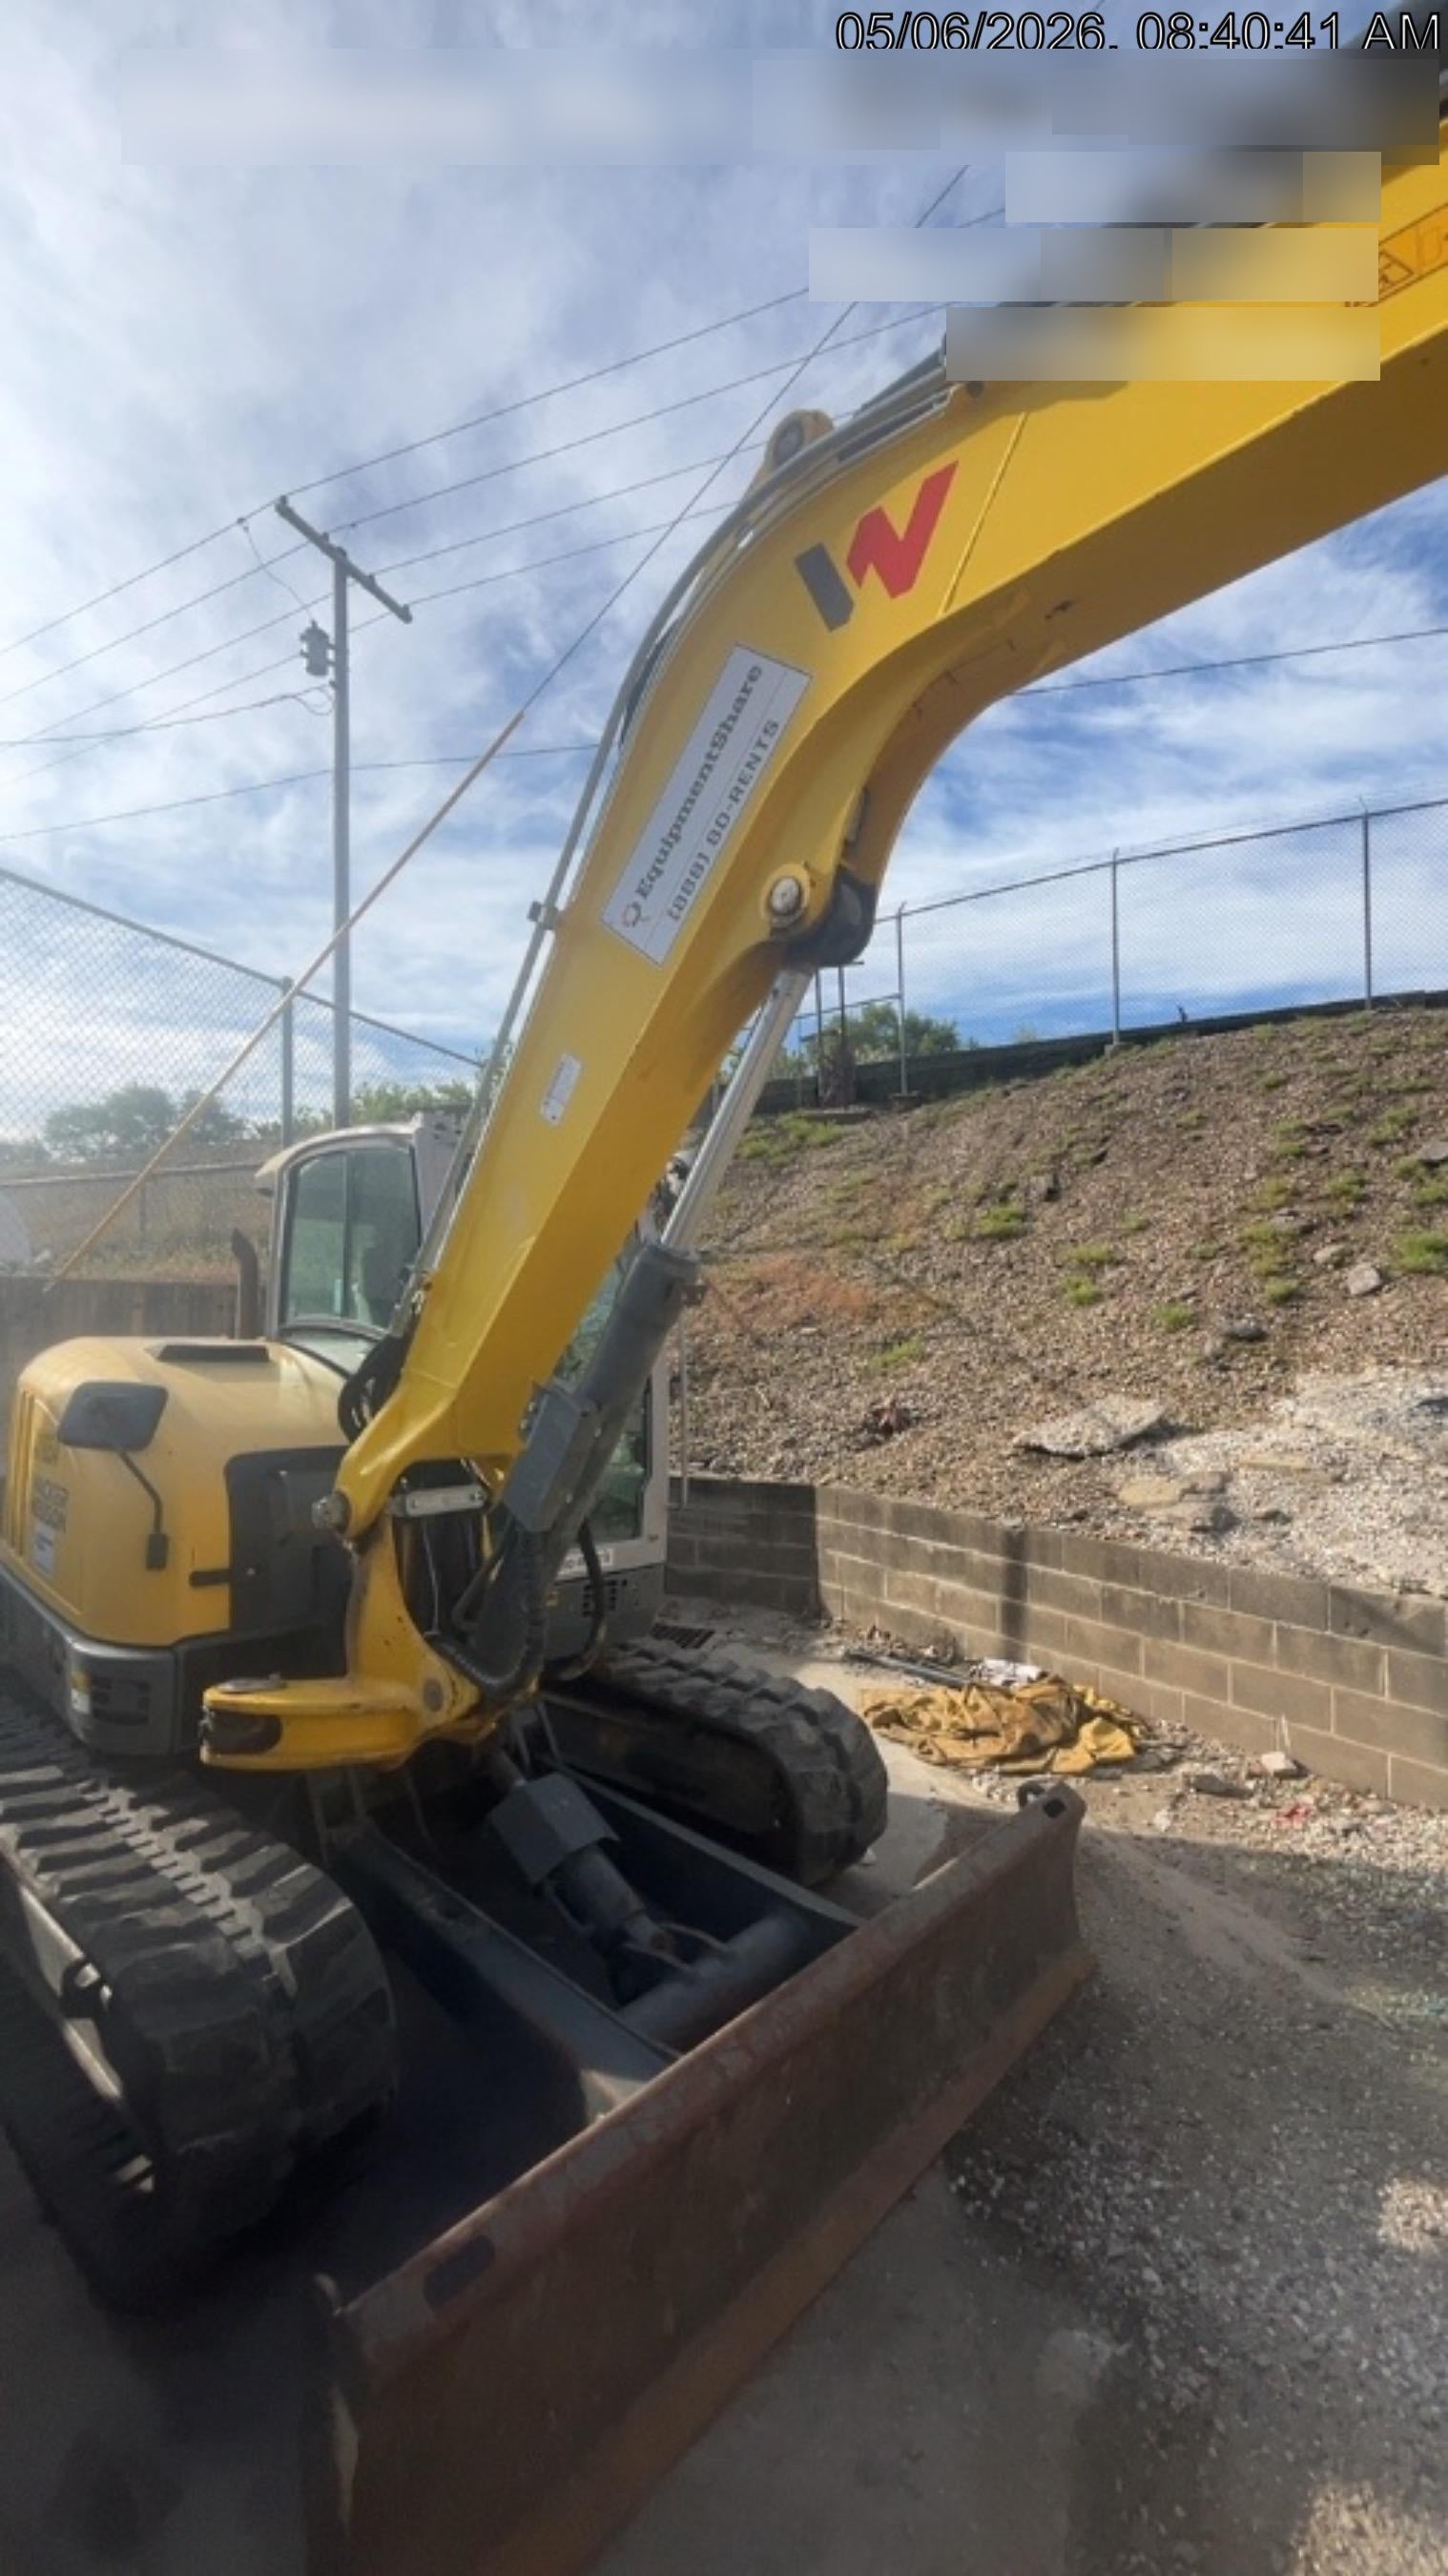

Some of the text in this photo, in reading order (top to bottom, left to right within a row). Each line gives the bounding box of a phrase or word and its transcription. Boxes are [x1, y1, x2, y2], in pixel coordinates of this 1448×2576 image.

[635, 665, 762, 900] EquipmentShare
[667, 719, 779, 922] (888) 80-RENTS
